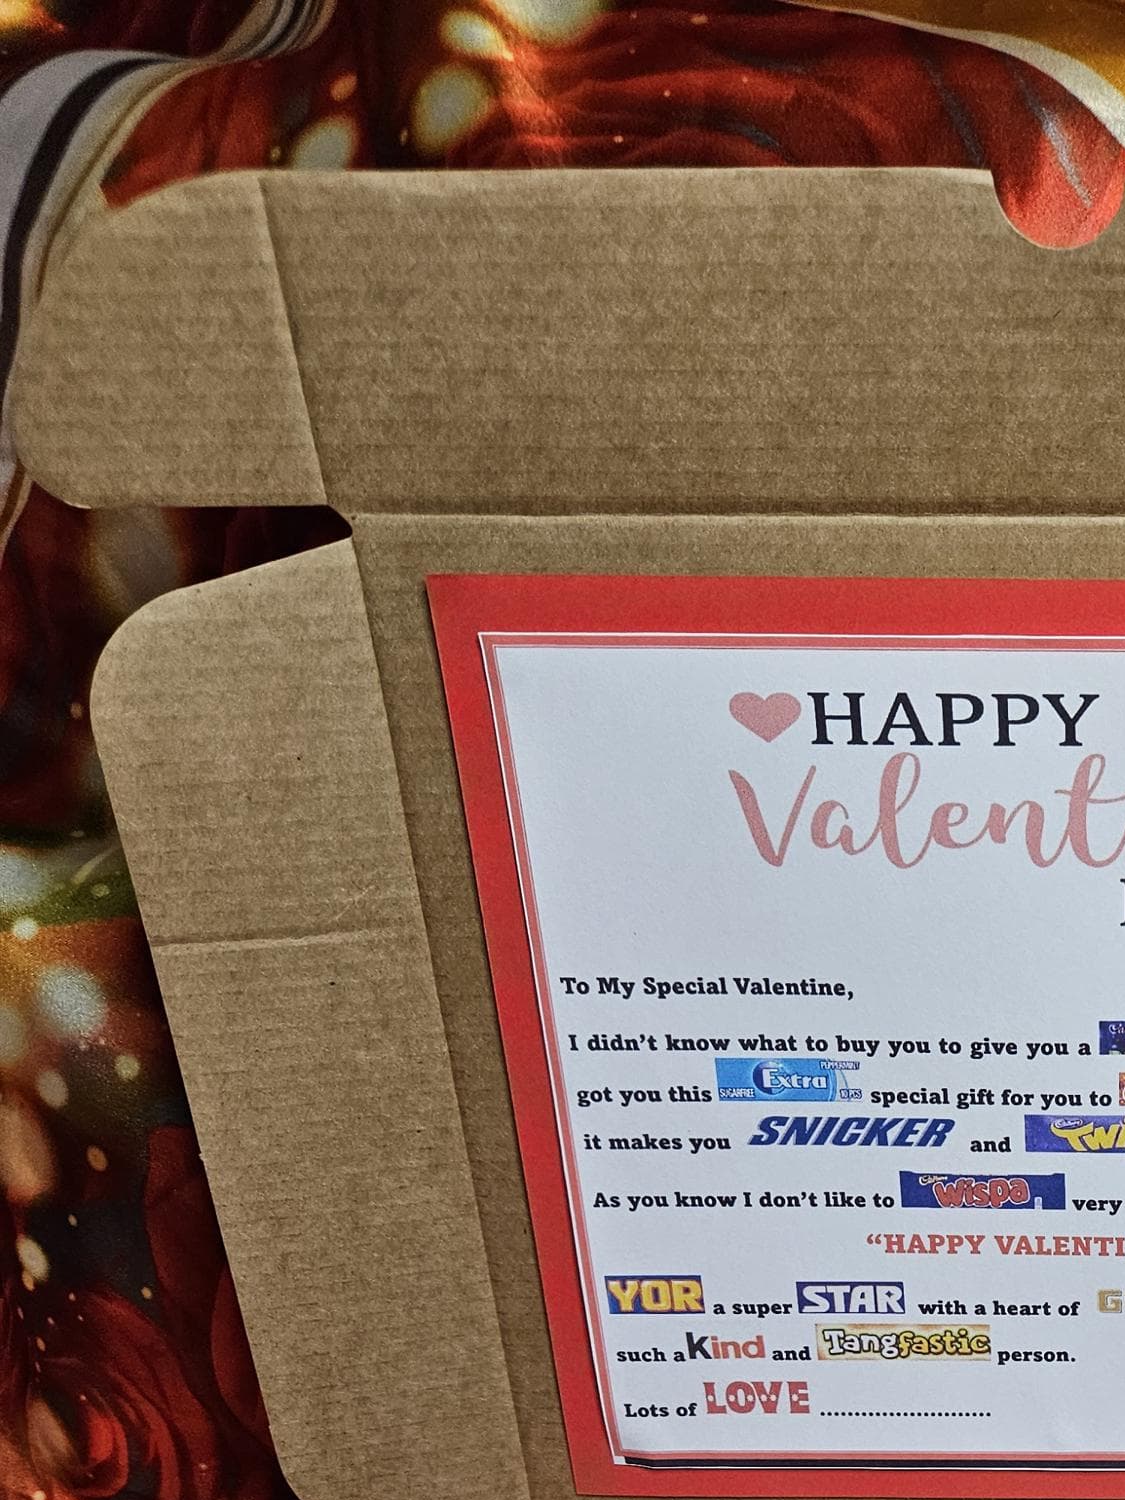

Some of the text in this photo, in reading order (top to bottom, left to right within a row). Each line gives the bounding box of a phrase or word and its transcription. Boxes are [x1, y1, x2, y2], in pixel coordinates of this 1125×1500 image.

[806, 691, 1100, 747] HAPPY
[559, 976, 854, 1001] To My Special Valentine,
[567, 1034, 579, 1052] I
[587, 1033, 658, 1052] didn't
[665, 1033, 731, 1052] know
[738, 1033, 799, 1052] what
[805, 1035, 829, 1052] to
[835, 1034, 881, 1058] buy
[887, 1040, 931, 1058] you
[938, 1037, 962, 1055] to
[969, 1037, 1018, 1060] give
[1025, 1042, 1070, 1061] you
[1077, 1042, 1092, 1056] a
[576, 1086, 612, 1108] got
[618, 1089, 663, 1108] you
[667, 1085, 713, 1103] this
[761, 1067, 828, 1090] Extra
[870, 1087, 951, 1109] special
[956, 1088, 995, 1110] gift
[1000, 1088, 1035, 1106] for
[1040, 1093, 1083, 1111] you
[1088, 1090, 1113, 1107] to
[583, 1133, 602, 1150] it
[608, 1133, 683, 1150] makes
[688, 1137, 732, 1155] you
[747, 1116, 956, 1148] SNICKER
[969, 1136, 1012, 1153] and
[592, 1192, 621, 1208] As
[626, 1195, 670, 1212] you
[673, 1191, 738, 1208] know
[742, 1191, 753, 1208] I
[758, 1191, 819, 1208] don't
[823, 1191, 867, 1208] like
[872, 1192, 895, 1209] to
[932, 1177, 1030, 1208] Wispa
[1071, 1199, 1123, 1216] very
[866, 1233, 985, 1256] "HAPPY
[607, 1279, 704, 1313] YOR
[712, 1303, 727, 1315] a
[731, 1303, 793, 1319] super
[801, 1284, 904, 1313] STAR
[917, 1299, 968, 1316] with
[974, 1303, 987, 1316] a
[992, 1300, 1052, 1316] heart
[1057, 1301, 1081, 1317] of
[616, 1347, 668, 1363] such
[673, 1350, 687, 1363] a
[771, 1345, 812, 1362] and
[822, 1328, 991, 1359] Tangfastic
[996, 1350, 1076, 1366] person.
[623, 1403, 670, 1418] Lots
[675, 1402, 698, 1417] of
[703, 1381, 810, 1414] LOVE
